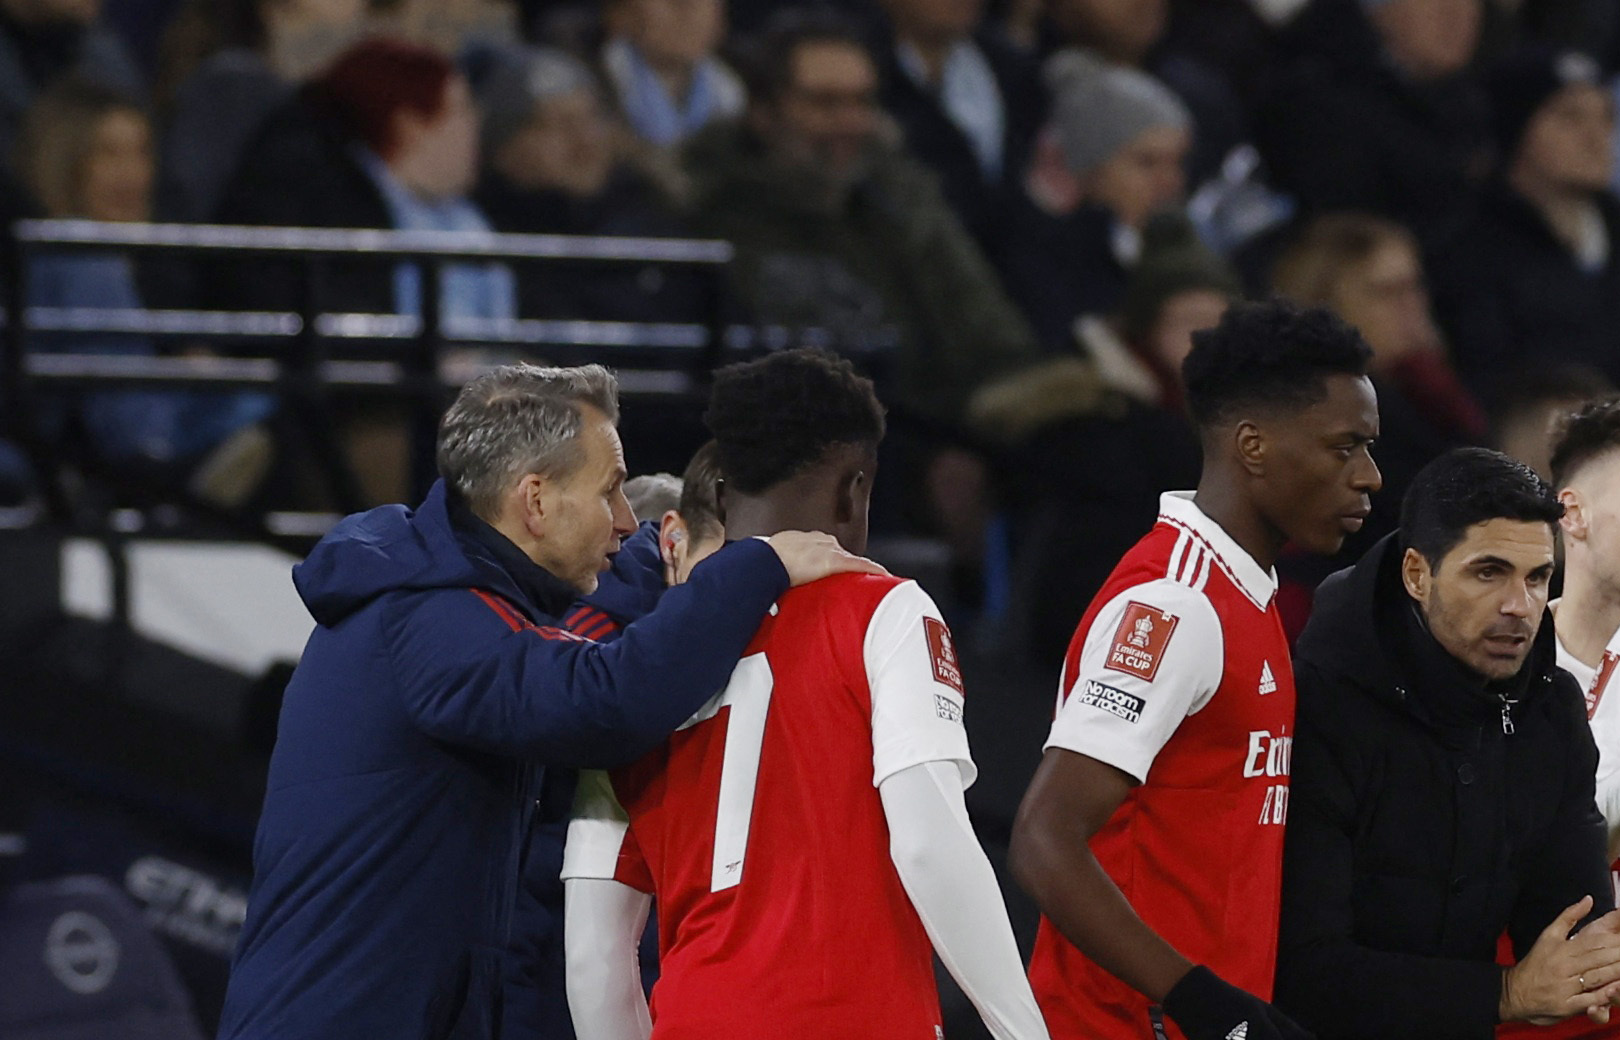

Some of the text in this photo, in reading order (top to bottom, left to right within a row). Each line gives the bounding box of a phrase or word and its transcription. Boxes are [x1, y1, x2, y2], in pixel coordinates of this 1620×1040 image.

[1112, 652, 1151, 671] FA CUP
[1115, 642, 1153, 662] Emirates
[1084, 681, 1139, 710] No room
[1096, 696, 1140, 723] racism
